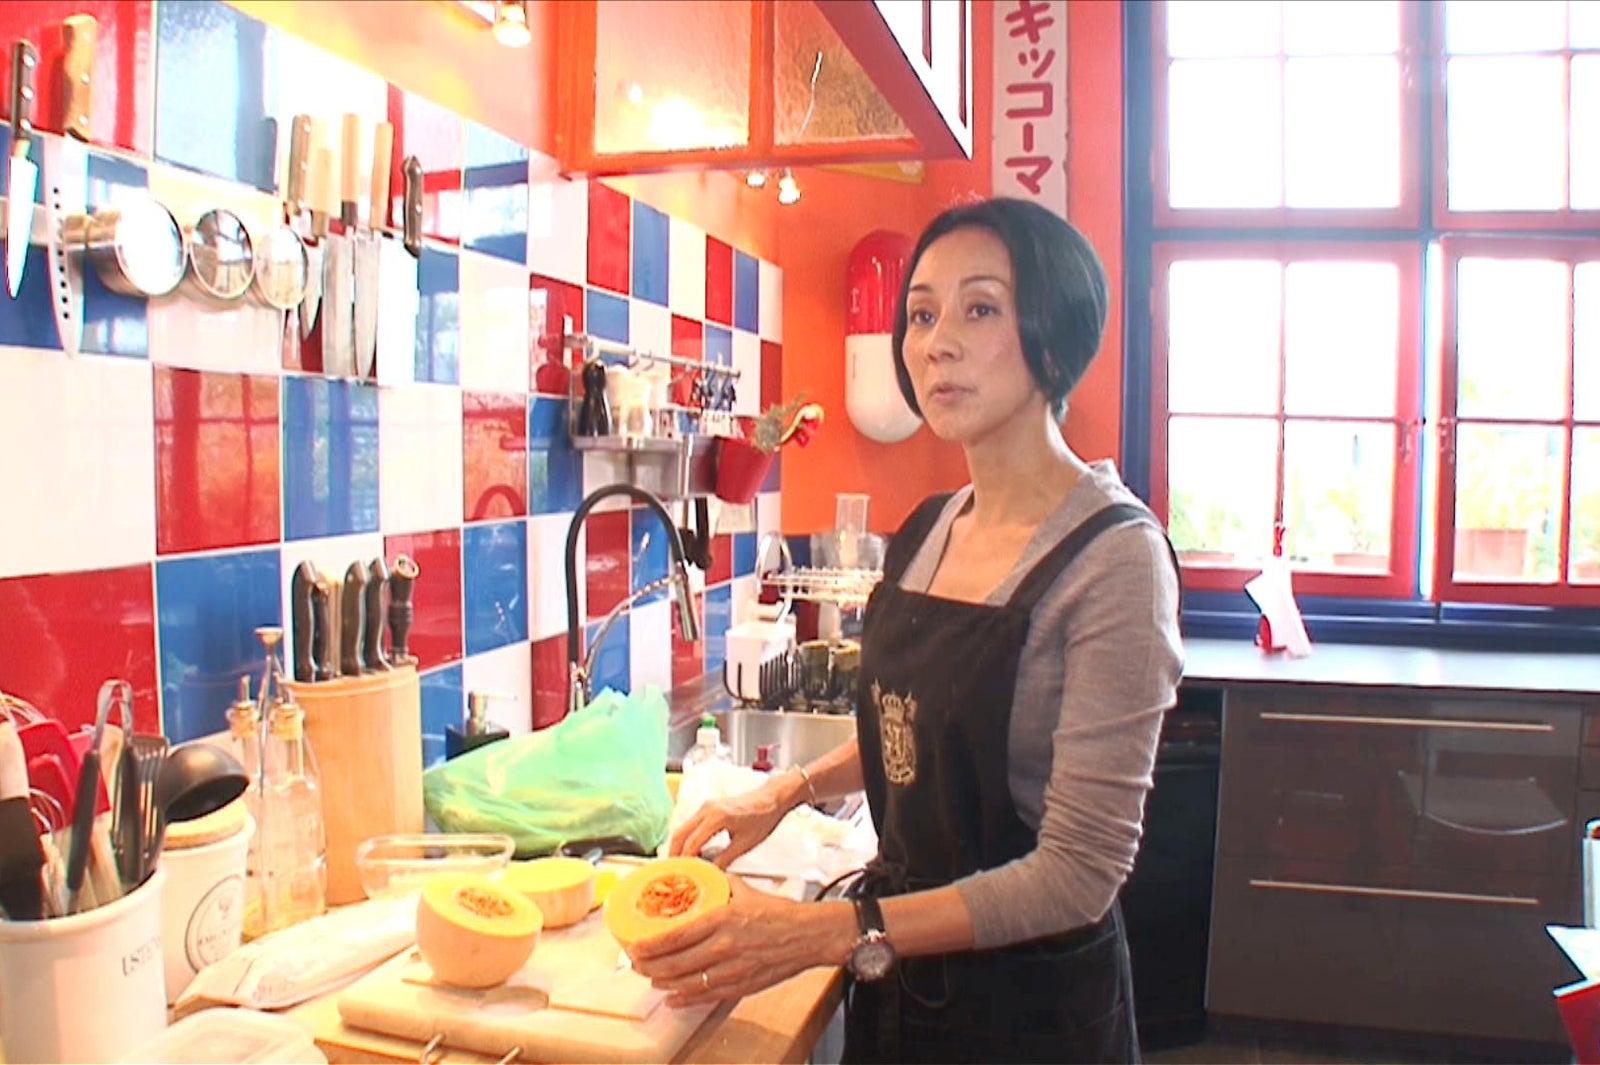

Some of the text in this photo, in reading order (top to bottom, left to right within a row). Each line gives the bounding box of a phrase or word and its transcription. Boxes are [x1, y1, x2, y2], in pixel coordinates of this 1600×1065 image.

[1005, 0, 1055, 194] キッコーマ
